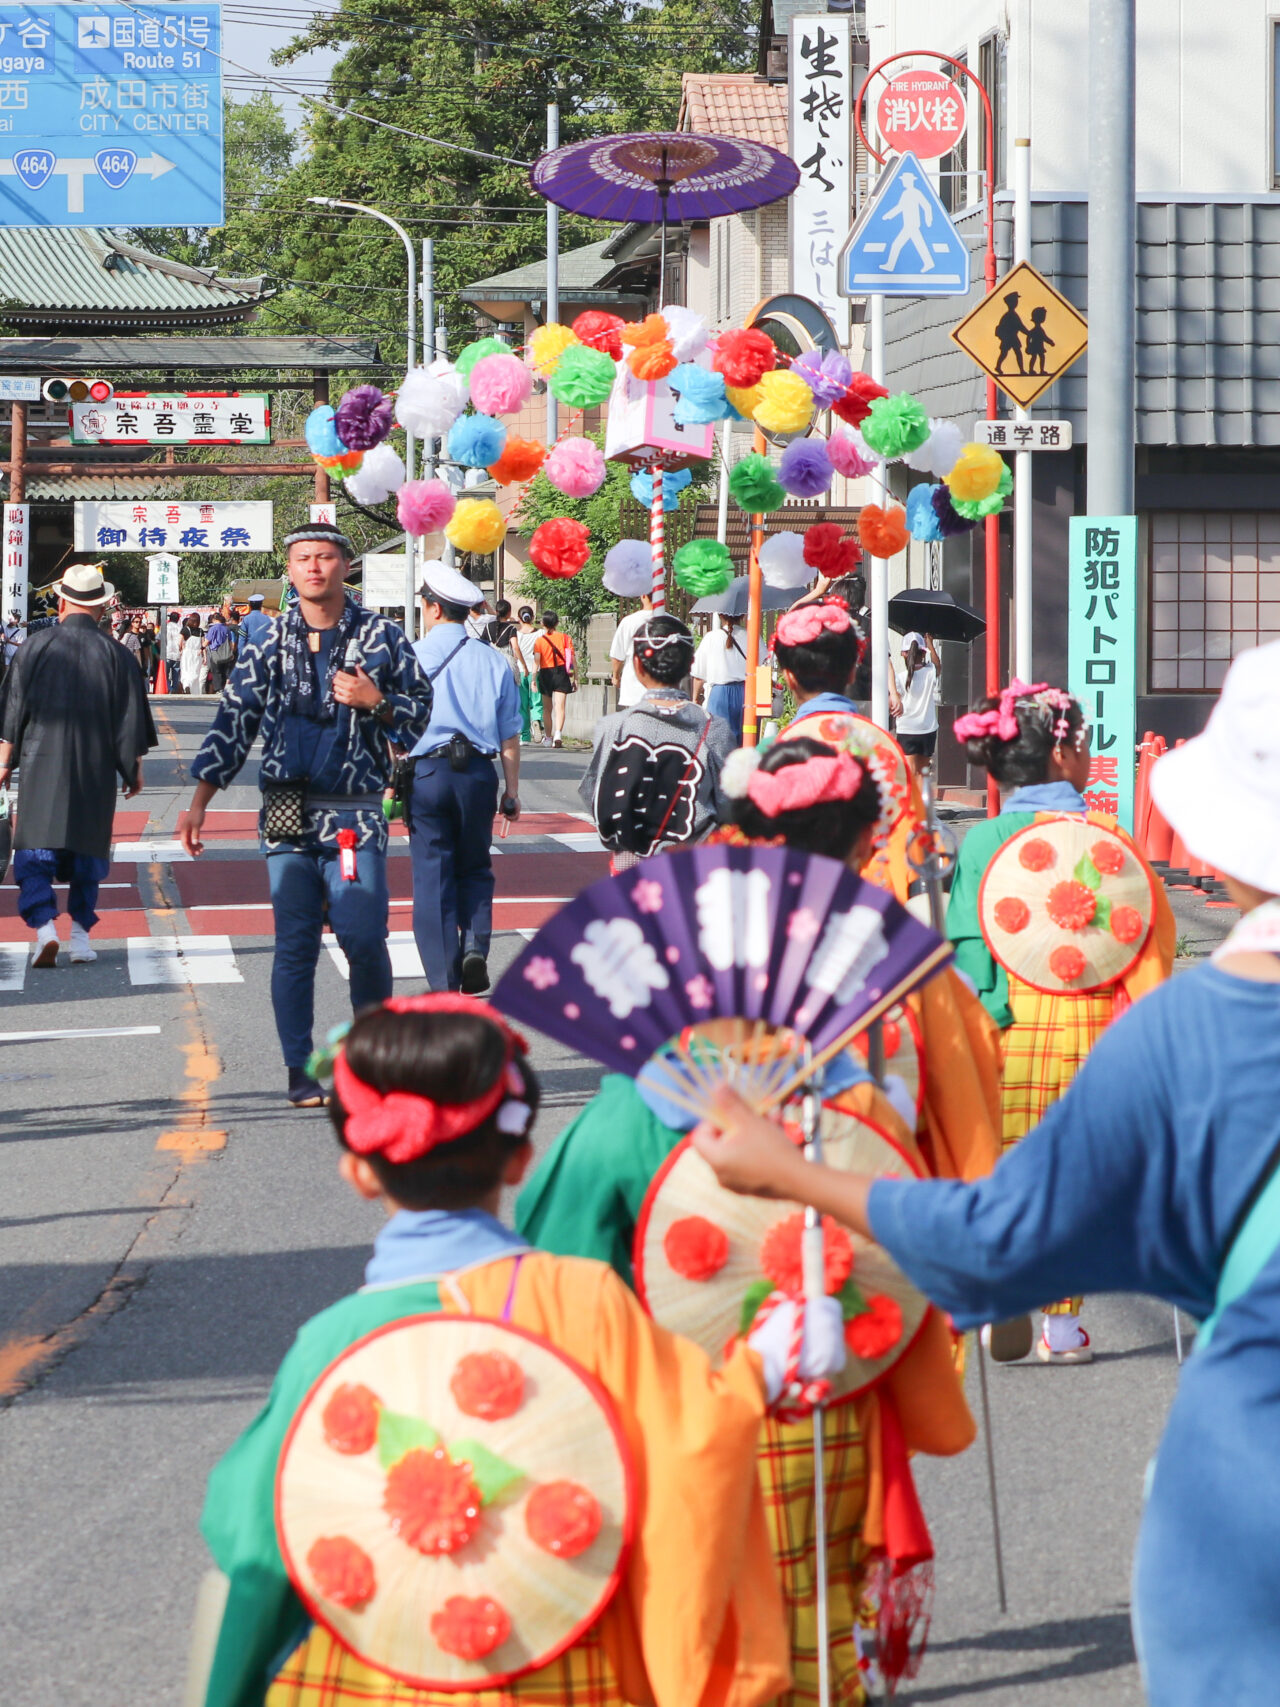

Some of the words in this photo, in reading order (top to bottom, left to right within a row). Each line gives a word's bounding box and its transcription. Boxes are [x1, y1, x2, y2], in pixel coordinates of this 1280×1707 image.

[114, 15, 211, 49] 国道51号
[124, 52, 175, 69] Route
[182, 52, 201, 68] 51
[80, 75, 210, 110] 成田市街
[890, 80, 909, 92] FIRE
[911, 80, 950, 92] HYDRANT
[80, 114, 121, 131] CITY
[133, 114, 209, 131] CENTER
[885, 97, 959, 132] 消火栓
[20, 156, 48, 175] 464
[102, 155, 130, 174] 464
[116, 413, 254, 435] 宗吾霊堂
[986, 425, 1060, 446] 通学路
[97, 527, 251, 547] 御待夜祭
